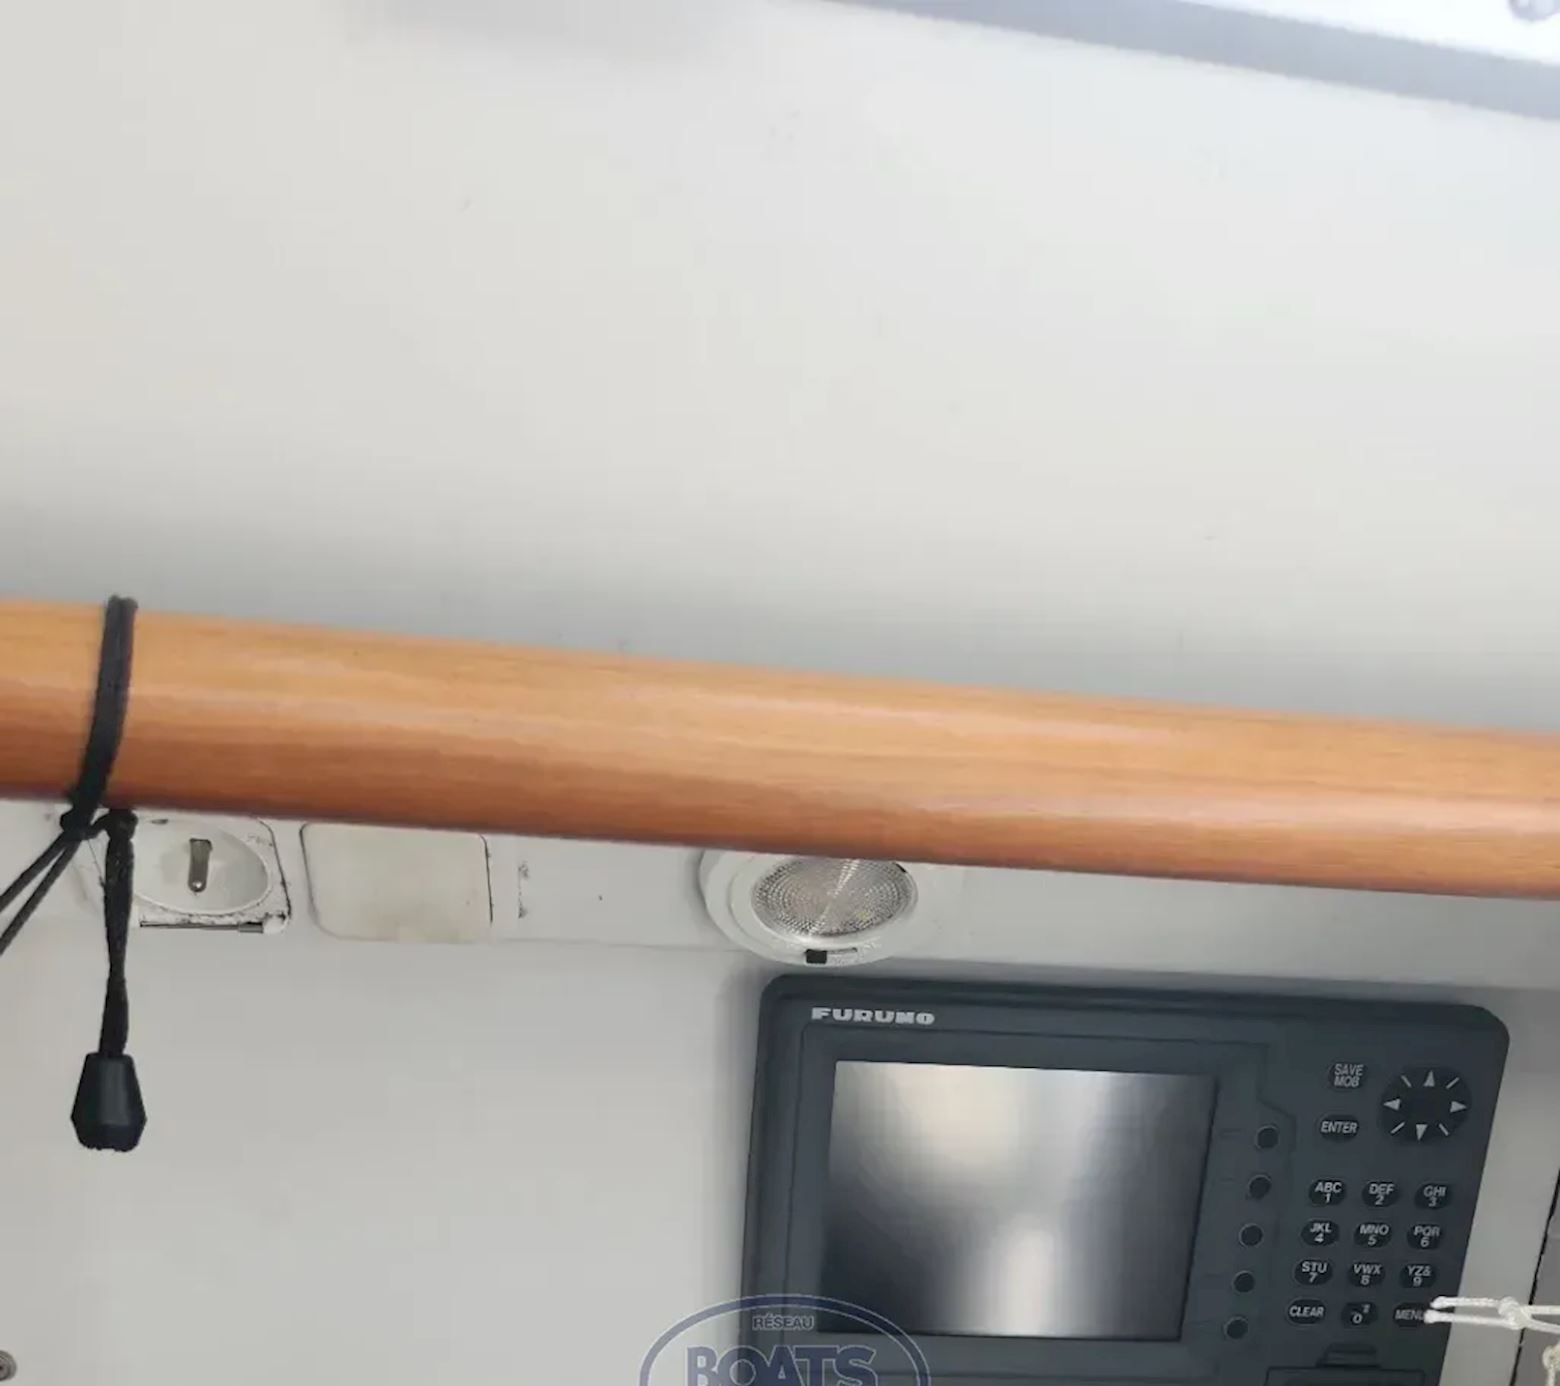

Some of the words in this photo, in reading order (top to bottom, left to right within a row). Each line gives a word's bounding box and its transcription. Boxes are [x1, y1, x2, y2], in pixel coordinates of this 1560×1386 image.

[811, 1007, 935, 1025] FURUNO
[1335, 1063, 1364, 1076] SAVE
[1334, 1076, 1360, 1087] MOB
[1321, 1121, 1358, 1134] ENTER
[1315, 1182, 1342, 1193] ABC
[1369, 1184, 1395, 1195] DEF
[1423, 1186, 1447, 1197] GHI
[1325, 1193, 1331, 1203] 1
[1375, 1194, 1385, 1205] 2
[1429, 1197, 1437, 1207] 3
[1310, 1223, 1332, 1233] JKL
[1360, 1224, 1389, 1235] MNO
[1314, 1233, 1325, 1243] 4
[1368, 1235, 1377, 1245] 5
[1420, 1237, 1429, 1247] 6
[1302, 1261, 1328, 1273] STU
[1354, 1264, 1382, 1275] VWX
[1309, 1273, 1318, 1283] 7
[1360, 1275, 1370, 1285] 8
[1413, 1276, 1422, 1286] 9
[1289, 1306, 1324, 1317] CLEAR
